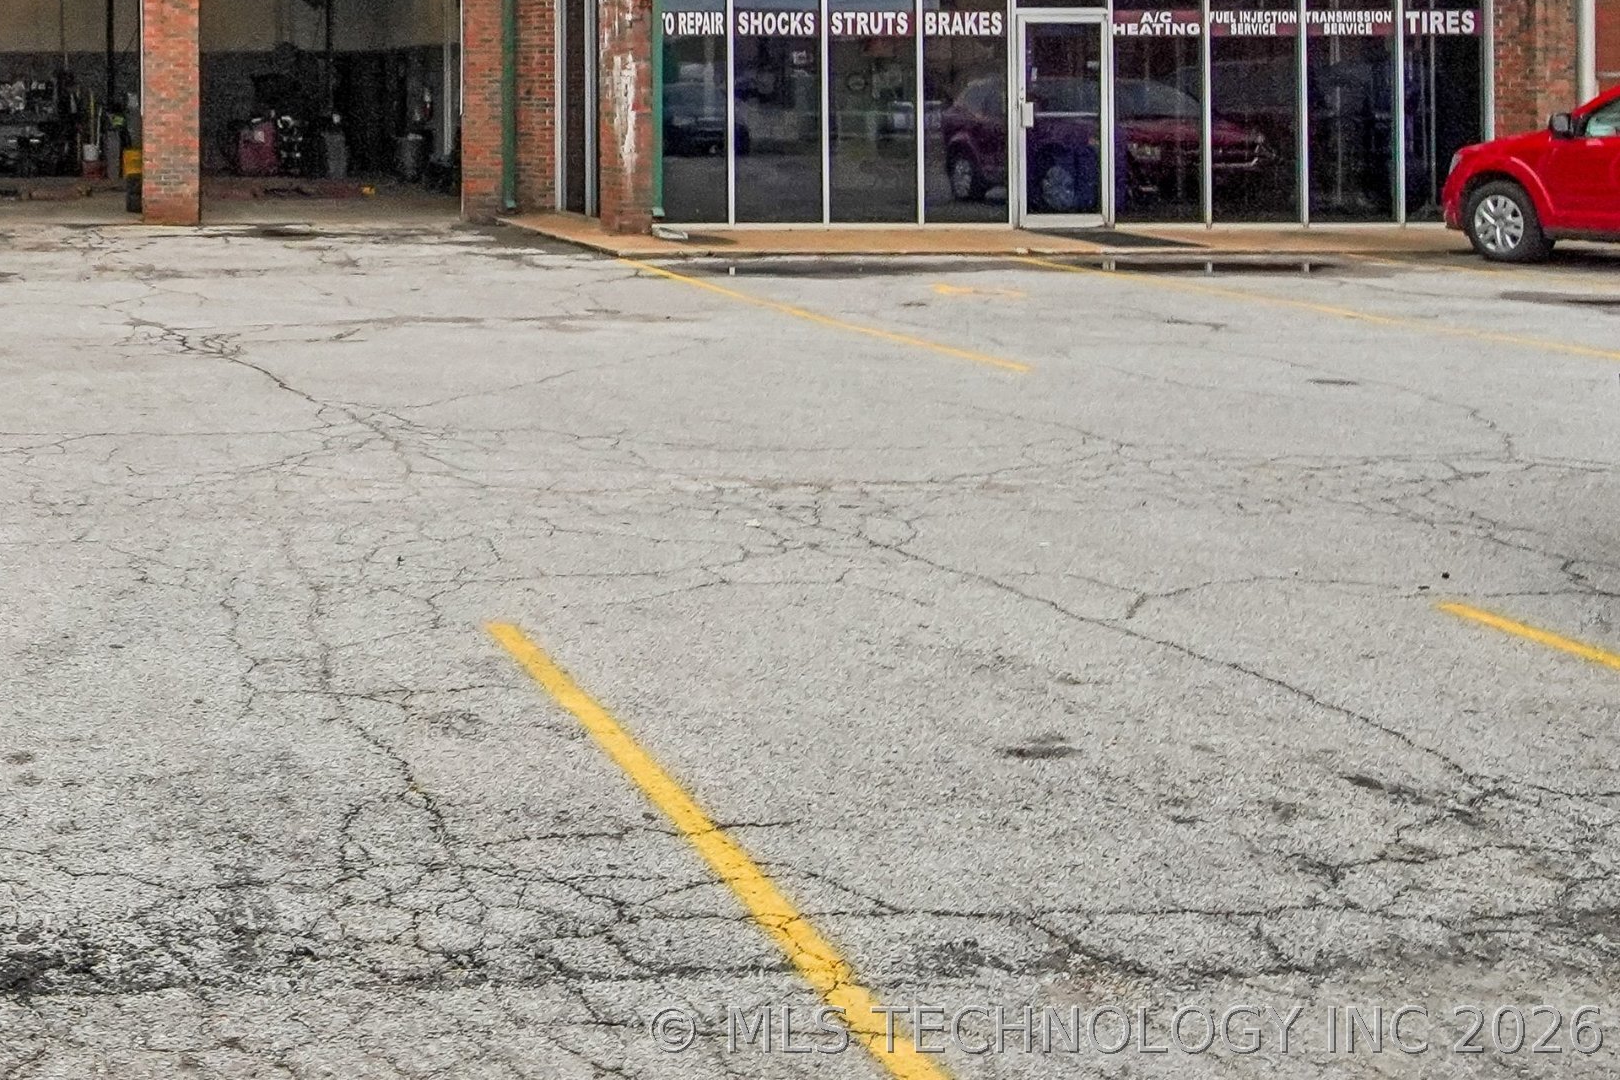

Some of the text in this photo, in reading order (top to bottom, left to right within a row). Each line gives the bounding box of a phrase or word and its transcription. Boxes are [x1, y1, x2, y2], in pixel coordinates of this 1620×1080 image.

[678, 11, 724, 35] REPAIR
[738, 11, 814, 35] SHOCKS
[831, 12, 908, 35] STRUTS
[925, 11, 1002, 35] BRAKES
[1141, 11, 1172, 23] A/C
[1210, 11, 1297, 24] FUEL INJECTION
[1306, 11, 1392, 23] TRANSMISSION
[1406, 10, 1475, 34] TIRES
[1113, 23, 1200, 35] HEATING
[1230, 24, 1276, 35] SERVICE
[1324, 23, 1372, 35] SERVICE
